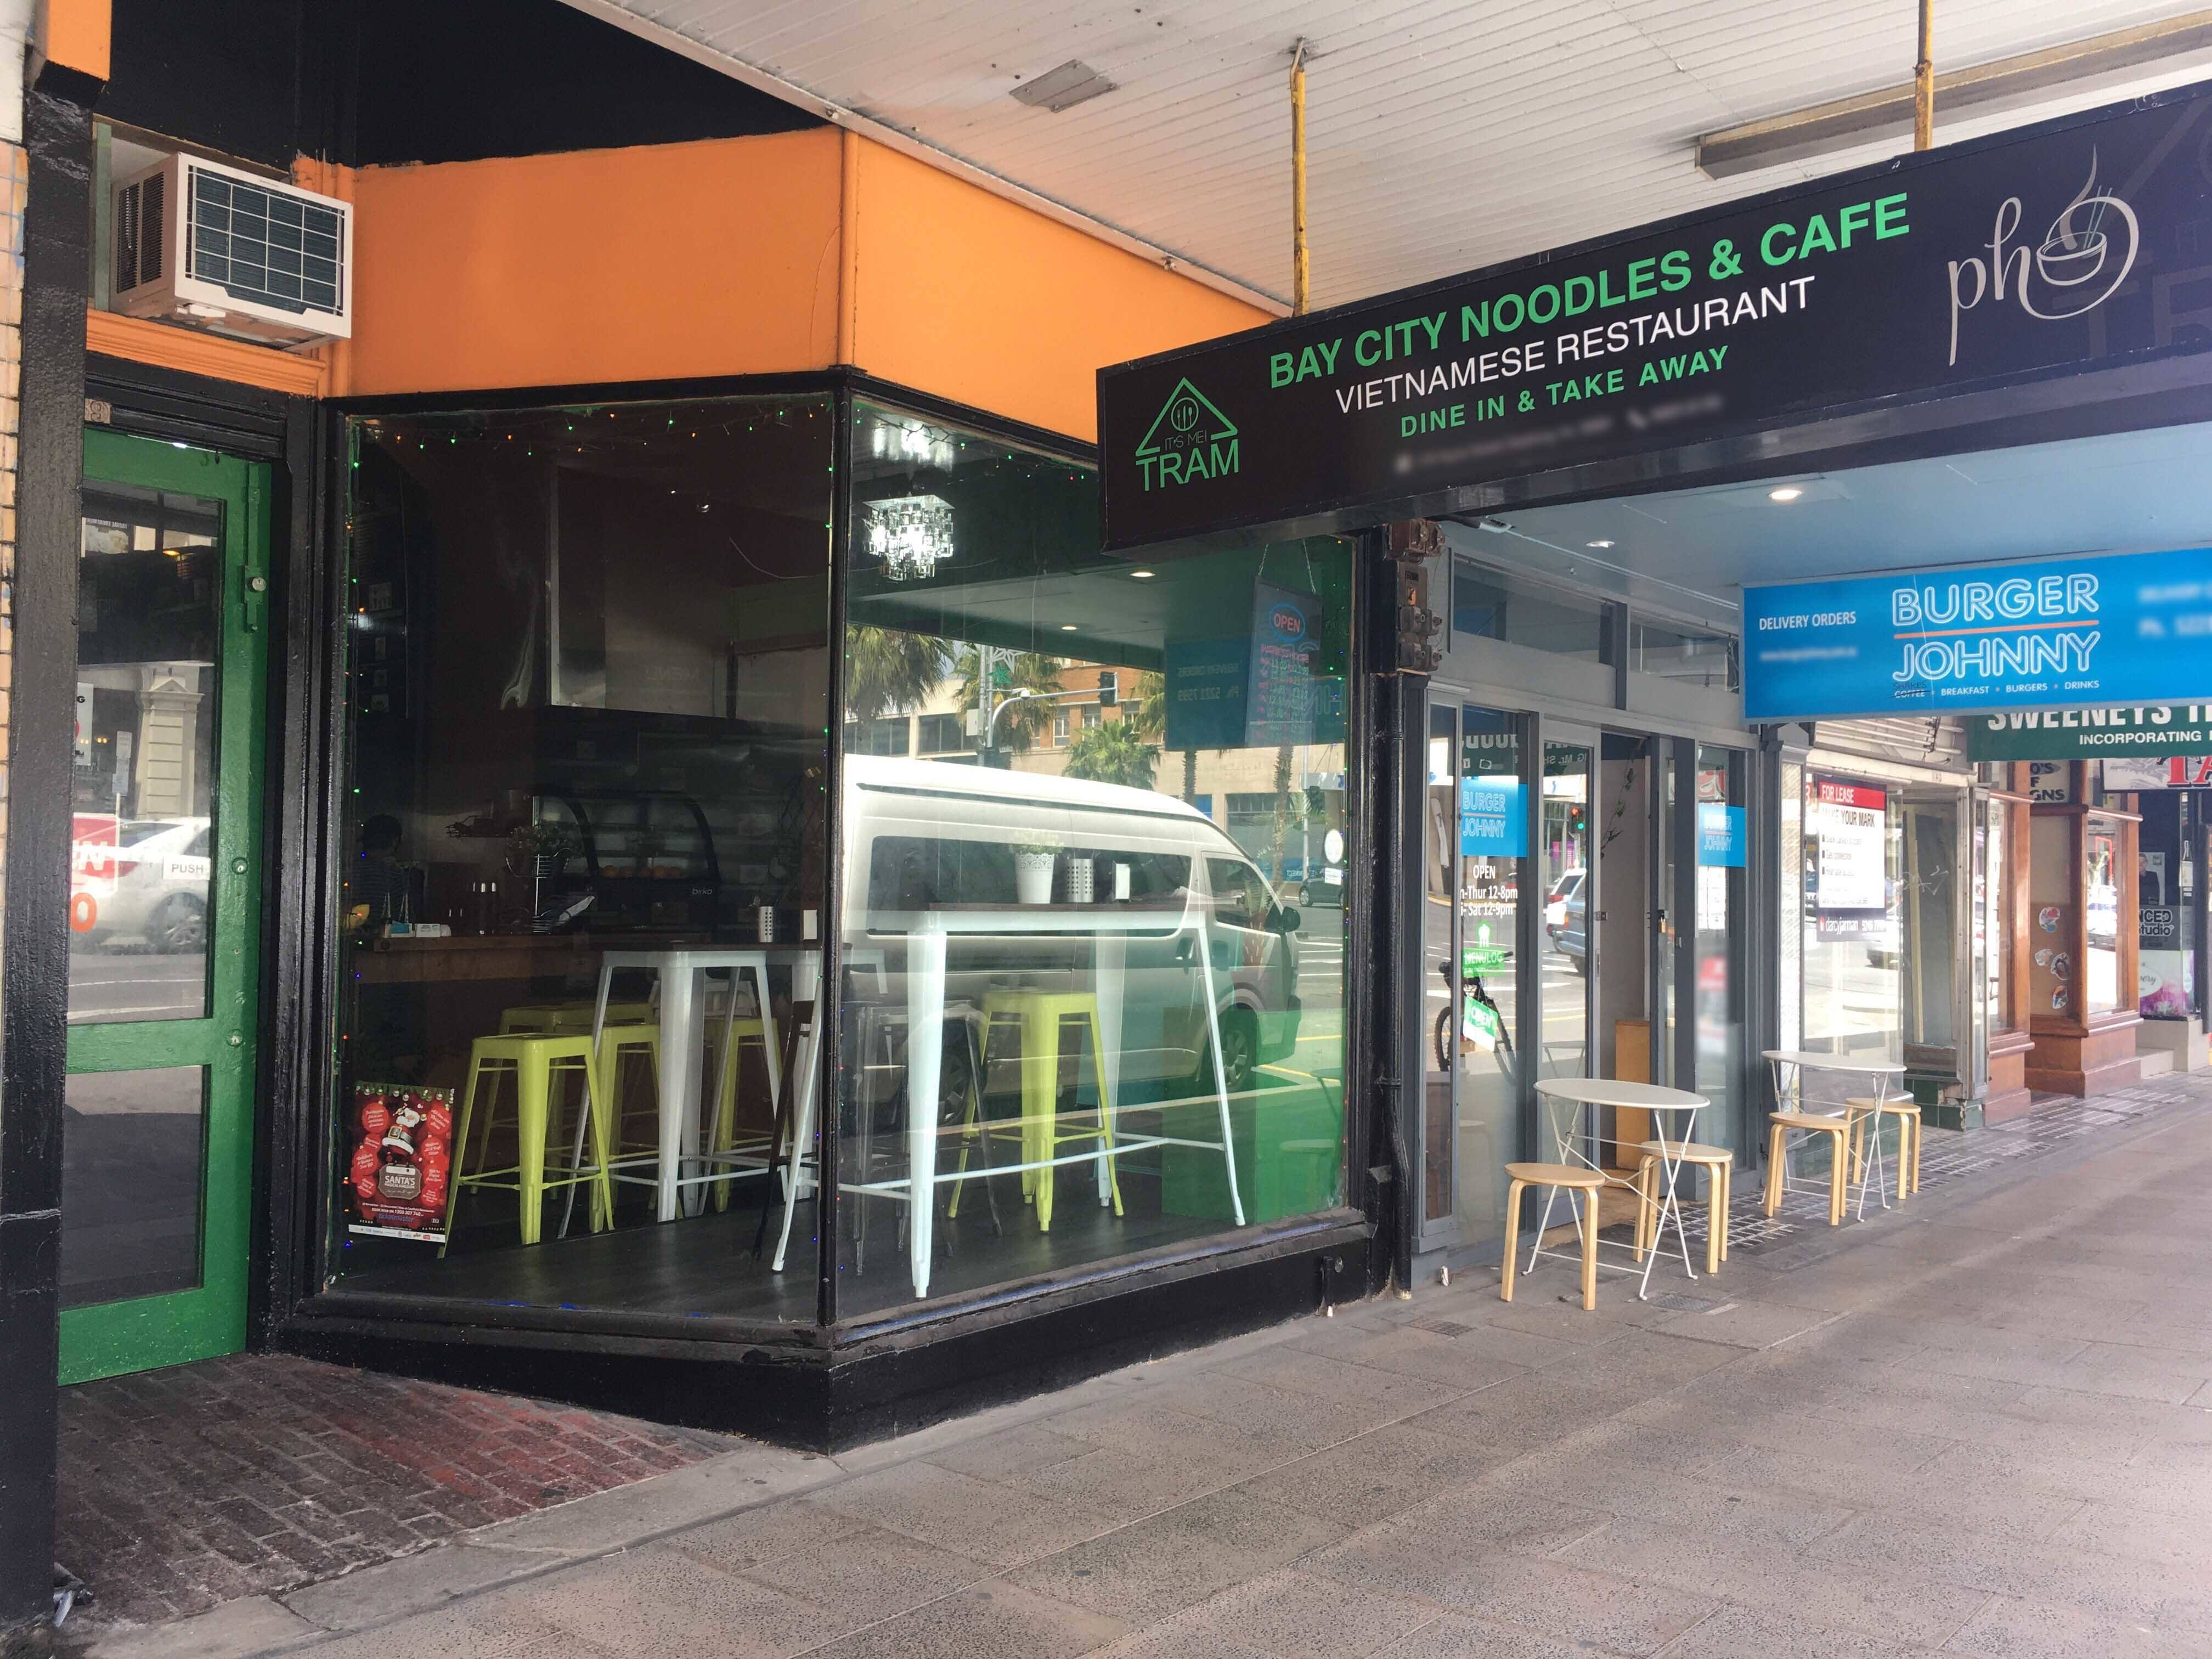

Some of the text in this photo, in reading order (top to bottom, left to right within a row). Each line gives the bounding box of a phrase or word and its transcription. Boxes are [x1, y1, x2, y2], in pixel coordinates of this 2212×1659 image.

[1270, 193, 1910, 388] BAY CITY NOODLES & CAFE
[1335, 275, 1815, 414] VIETNAMESE RESTAURANT
[1401, 345, 1729, 438] DINE IN & TAKE AWAY
[1165, 435, 1184, 451] IT'S
[1136, 438, 1239, 492] TRAM
[1892, 573, 2100, 627] BURGER
[1273, 613, 1301, 633] OPEN
[1759, 611, 1857, 630] DELIVERY ORDERS
[1892, 631, 2101, 682] JOHNNY
[1940, 686, 1990, 696] BREAKFAST
[2006, 682, 2048, 693] BURGERS
[2064, 680, 2100, 690] DRINKS
[2080, 730, 2202, 745] INCORPORATING
[1463, 791, 1505, 812] BURGER
[1822, 784, 1854, 803] FOR LEASE
[1463, 817, 1505, 838] JOHNNY
[1841, 810, 1857, 826] YOUR
[1858, 811, 1875, 827] MARK
[171, 863, 204, 873] PUSH
[1472, 865, 1496, 879] OPEN
[1488, 885, 1518, 902] 12-8pm
[1468, 902, 1482, 916] Sat
[1483, 901, 1514, 919] 12-9pm
[1464, 951, 1503, 965] MENULOG
[385, 1175, 415, 1186] SANTA'S
